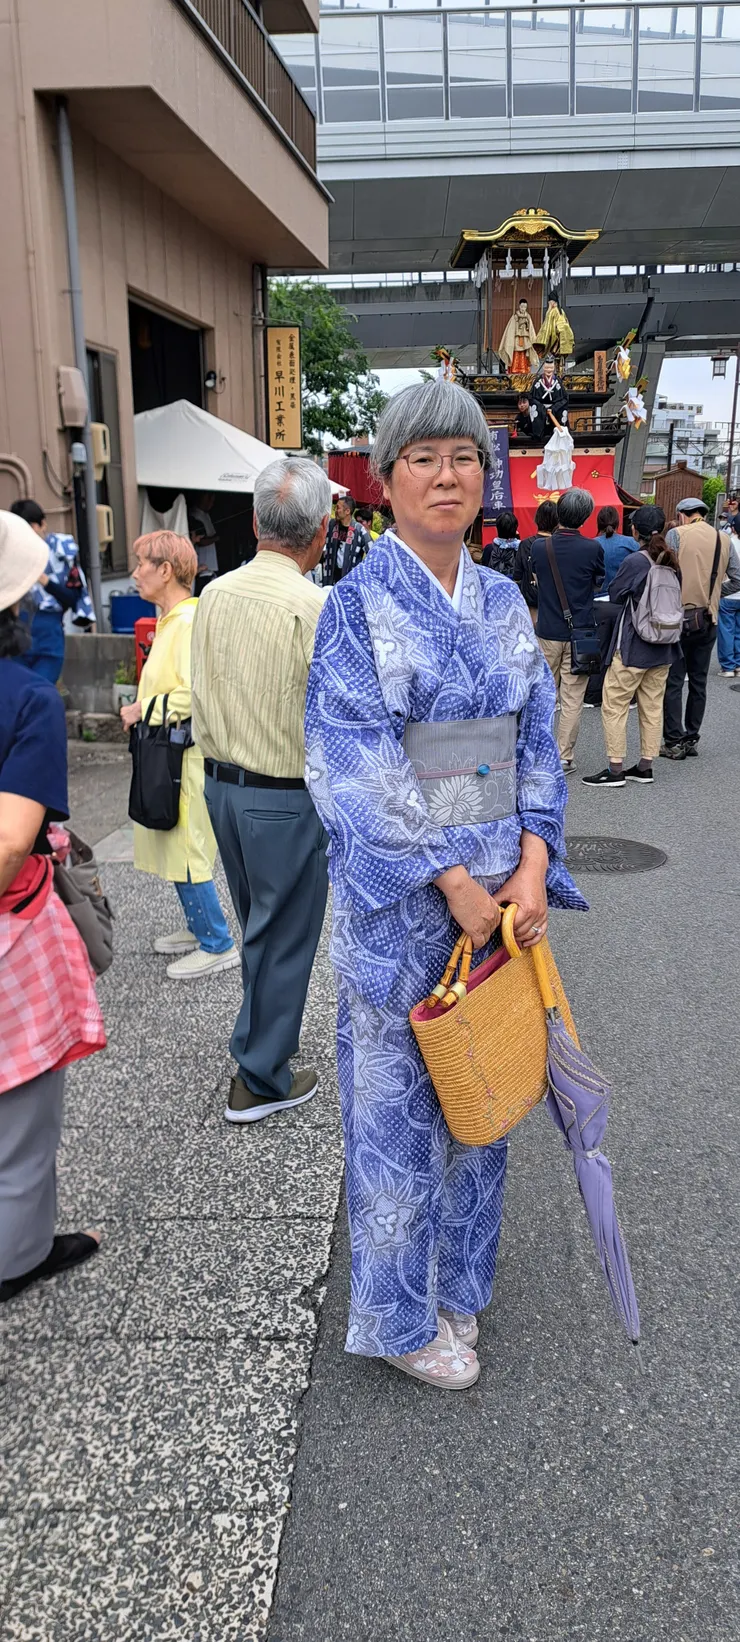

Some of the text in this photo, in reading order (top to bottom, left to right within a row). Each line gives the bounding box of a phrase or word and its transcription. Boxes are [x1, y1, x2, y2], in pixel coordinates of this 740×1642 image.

[274, 370, 286, 441] 早川工業所
